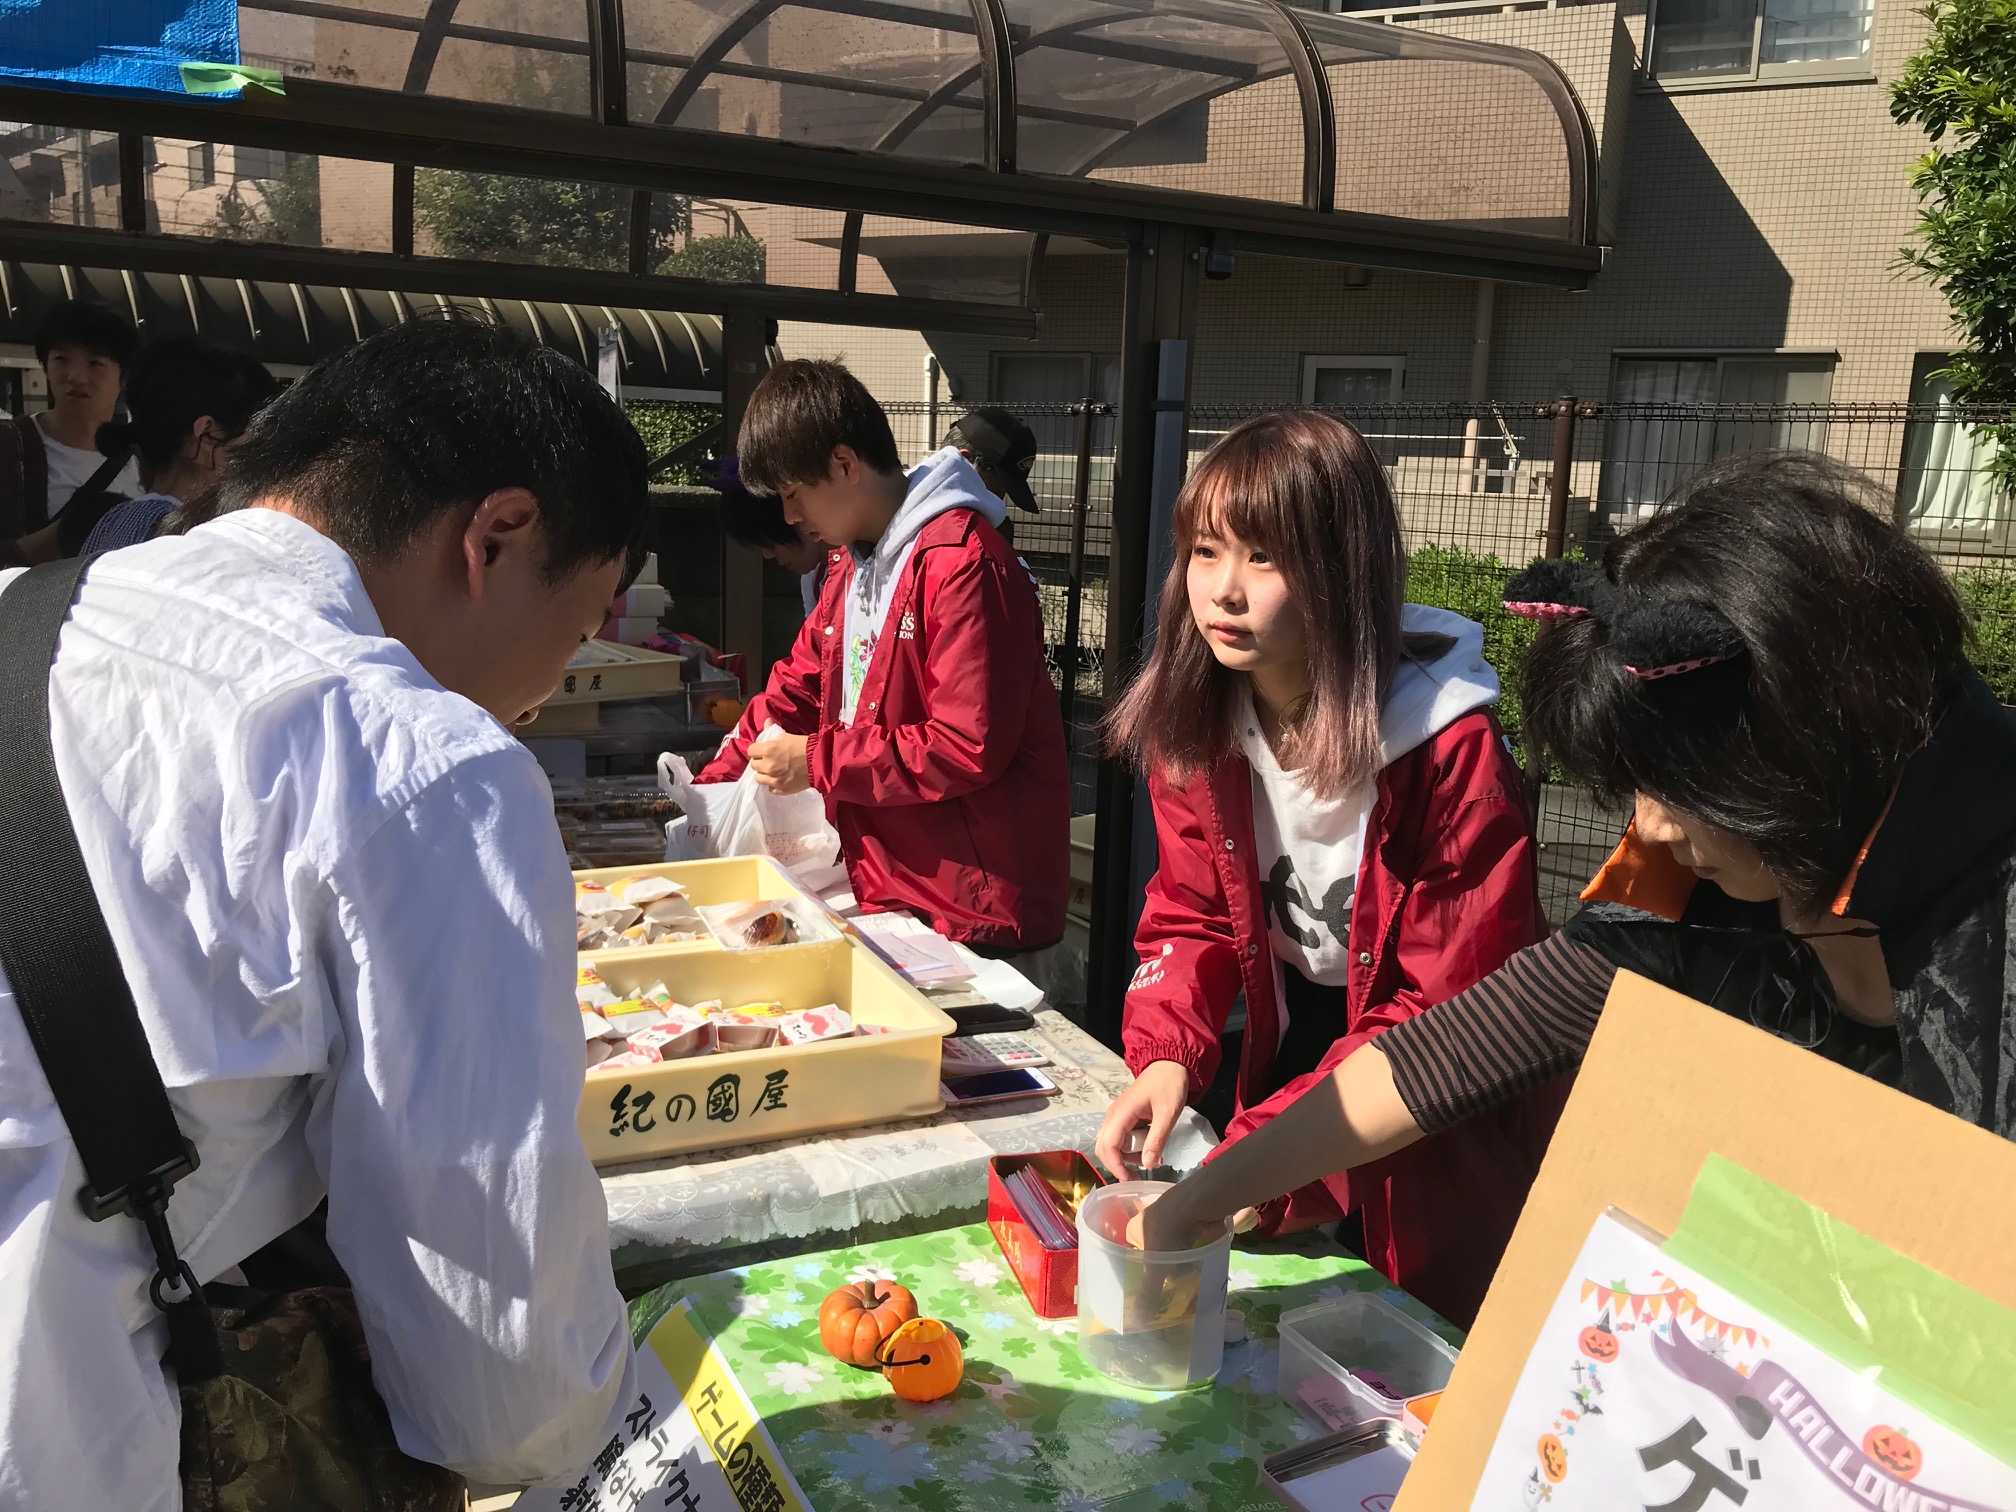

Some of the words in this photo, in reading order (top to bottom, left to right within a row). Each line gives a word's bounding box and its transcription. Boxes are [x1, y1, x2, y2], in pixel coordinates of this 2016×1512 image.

[609, 1068, 790, 1138] 紀の國屋
[1767, 1378, 1972, 1512] HALLOW
